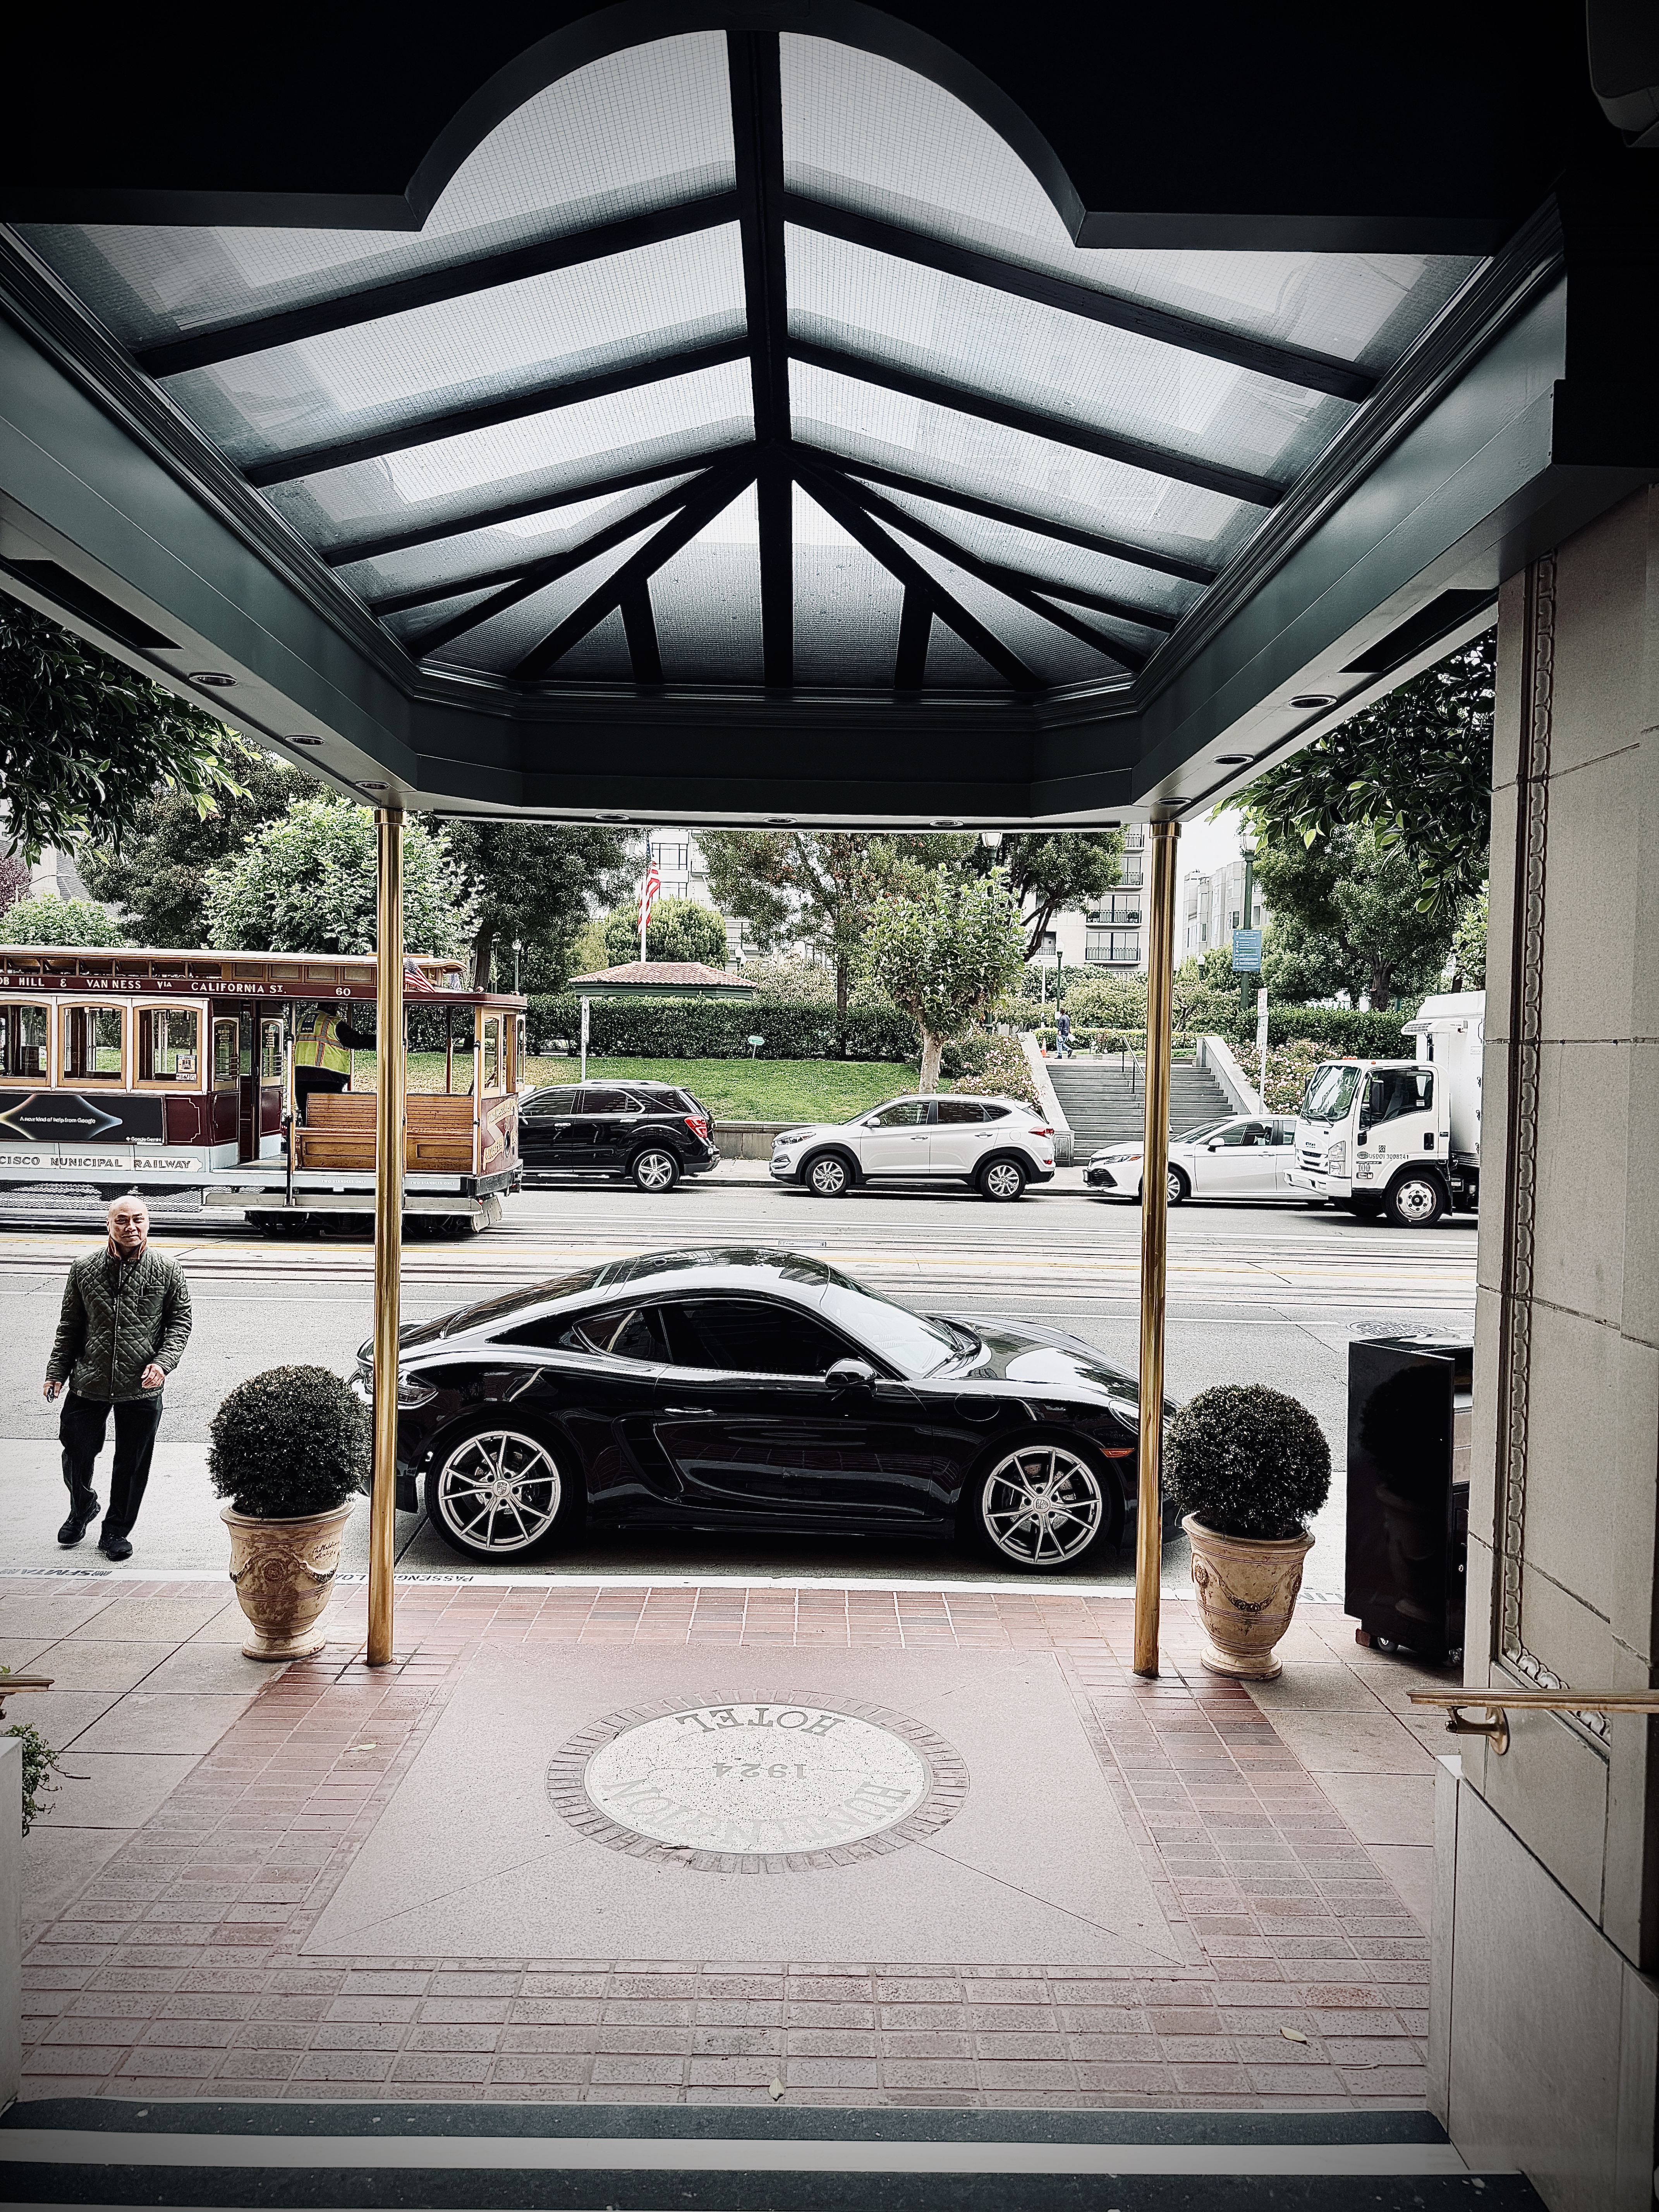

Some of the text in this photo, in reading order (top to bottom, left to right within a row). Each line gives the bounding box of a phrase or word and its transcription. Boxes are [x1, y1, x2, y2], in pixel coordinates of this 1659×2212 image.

[19, 977, 45, 986] HILL
[60, 979, 67, 987] &
[86, 979, 108, 988] VAN
[112, 980, 141, 989] NESS
[191, 982, 264, 993] CALIFORNIA
[336, 988, 351, 996] 60
[50, 1158, 122, 1168] MUNICIPAL
[134, 1159, 191, 1168] RAILWAY
[1358, 1163, 1370, 1172] 100
[675, 1707, 845, 1737] HOTEL
[712, 1762, 806, 1779] 1924
[604, 1778, 912, 1846] HUNTINGTON
